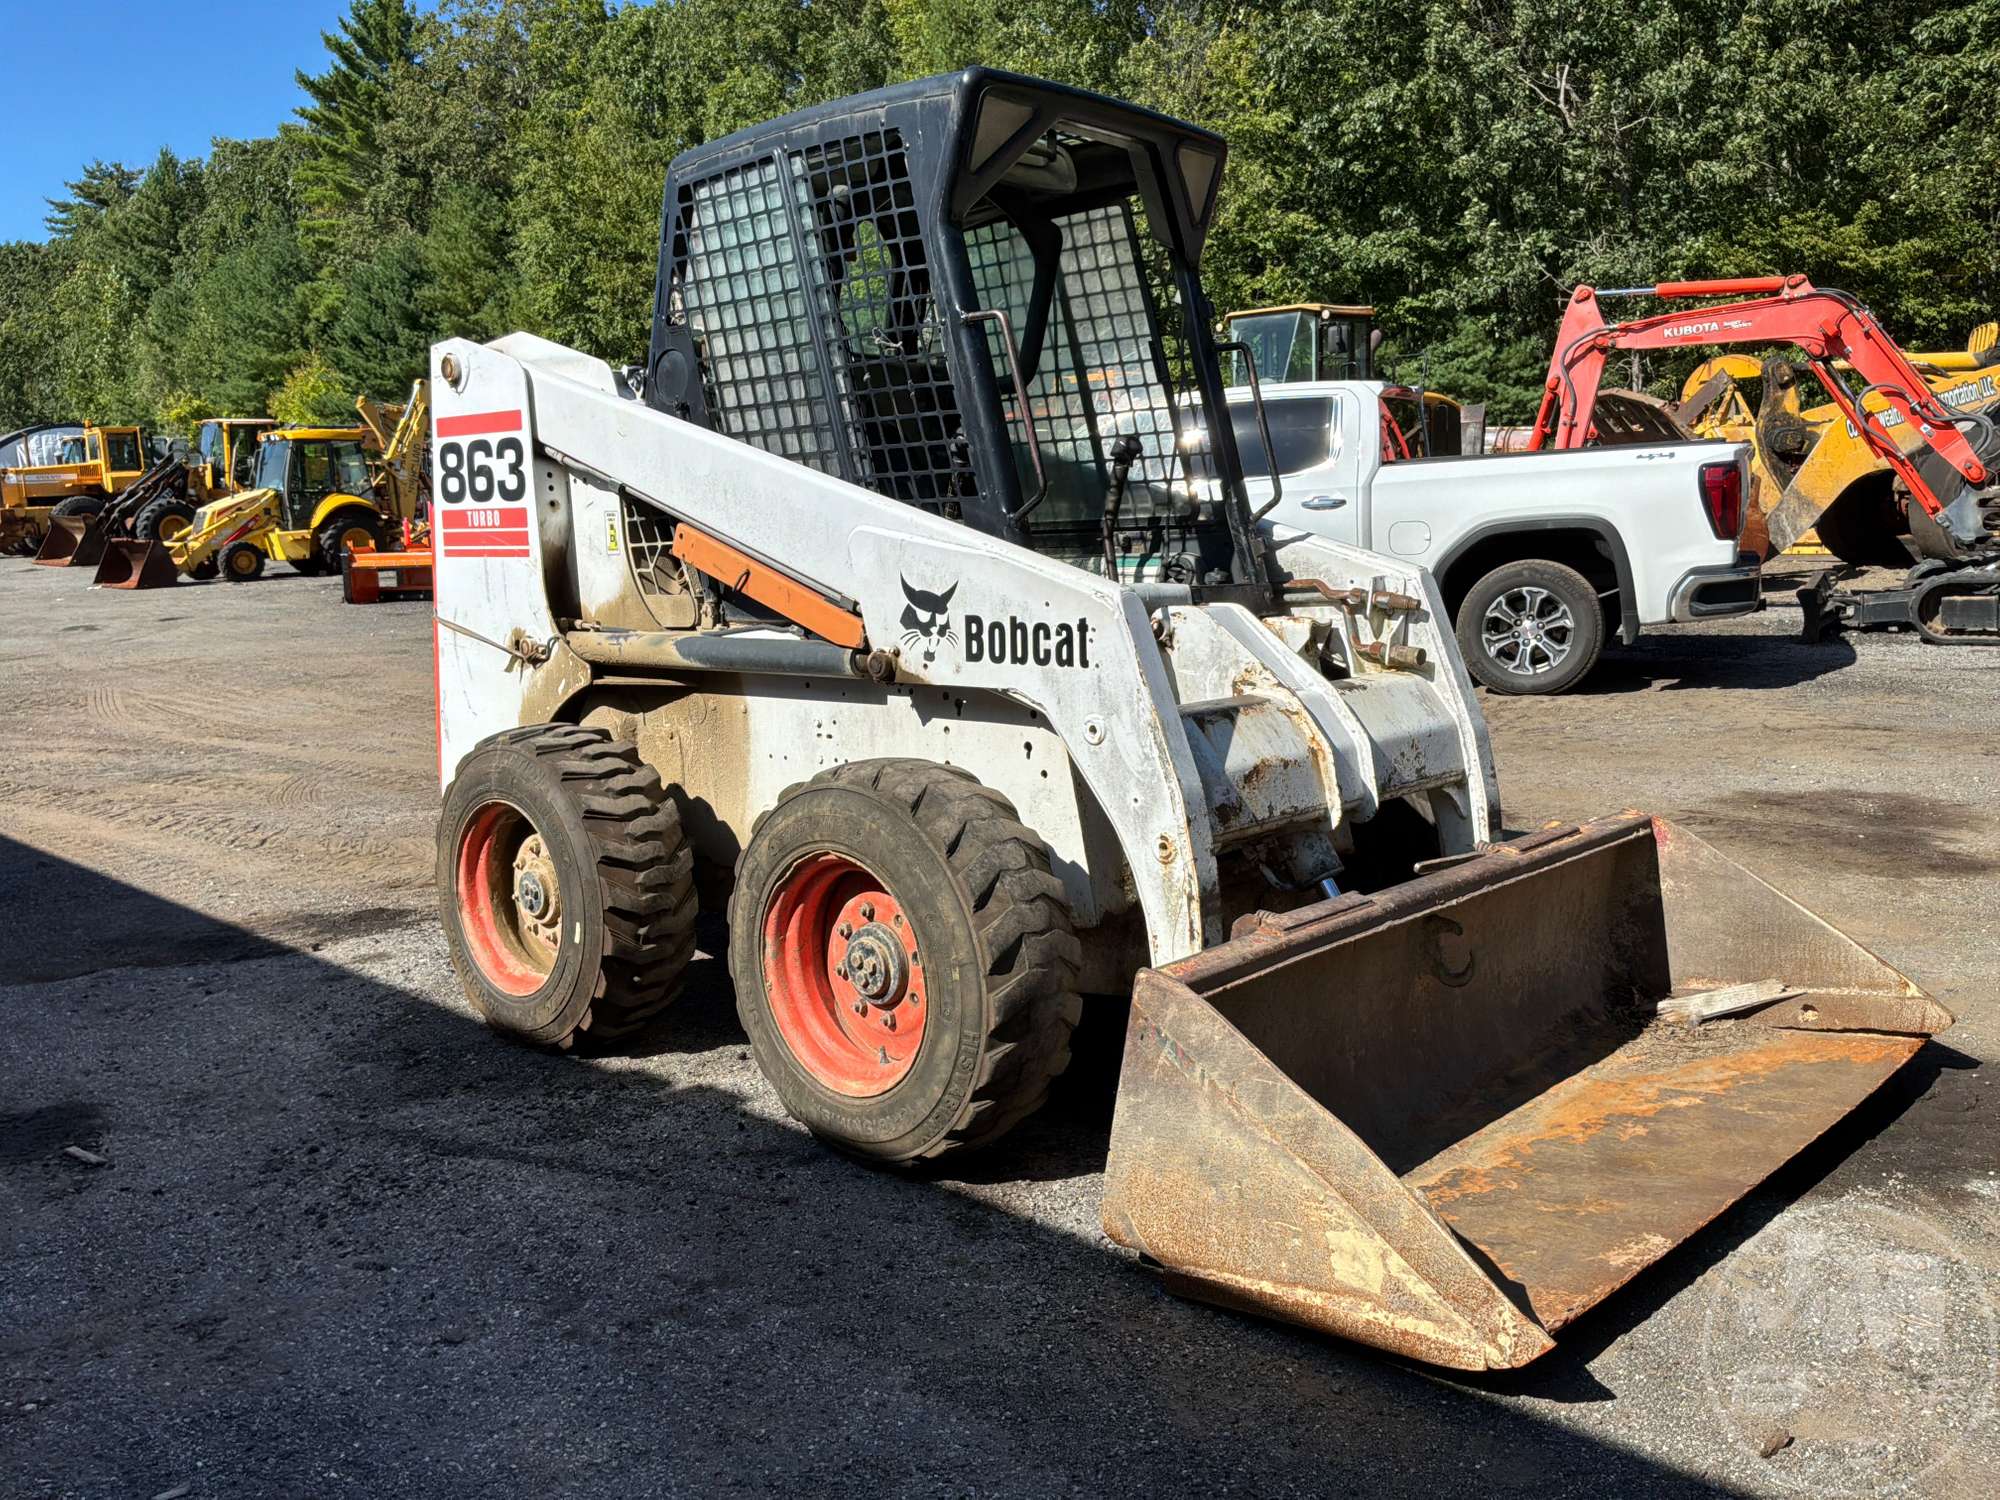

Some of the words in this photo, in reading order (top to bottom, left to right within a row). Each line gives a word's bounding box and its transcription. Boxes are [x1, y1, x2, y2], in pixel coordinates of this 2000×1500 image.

[1663, 321, 1719, 338] KUBOTA
[440, 437, 526, 504] 863
[467, 511, 500, 527] TURBO
[965, 614, 1089, 669] Bobcat
